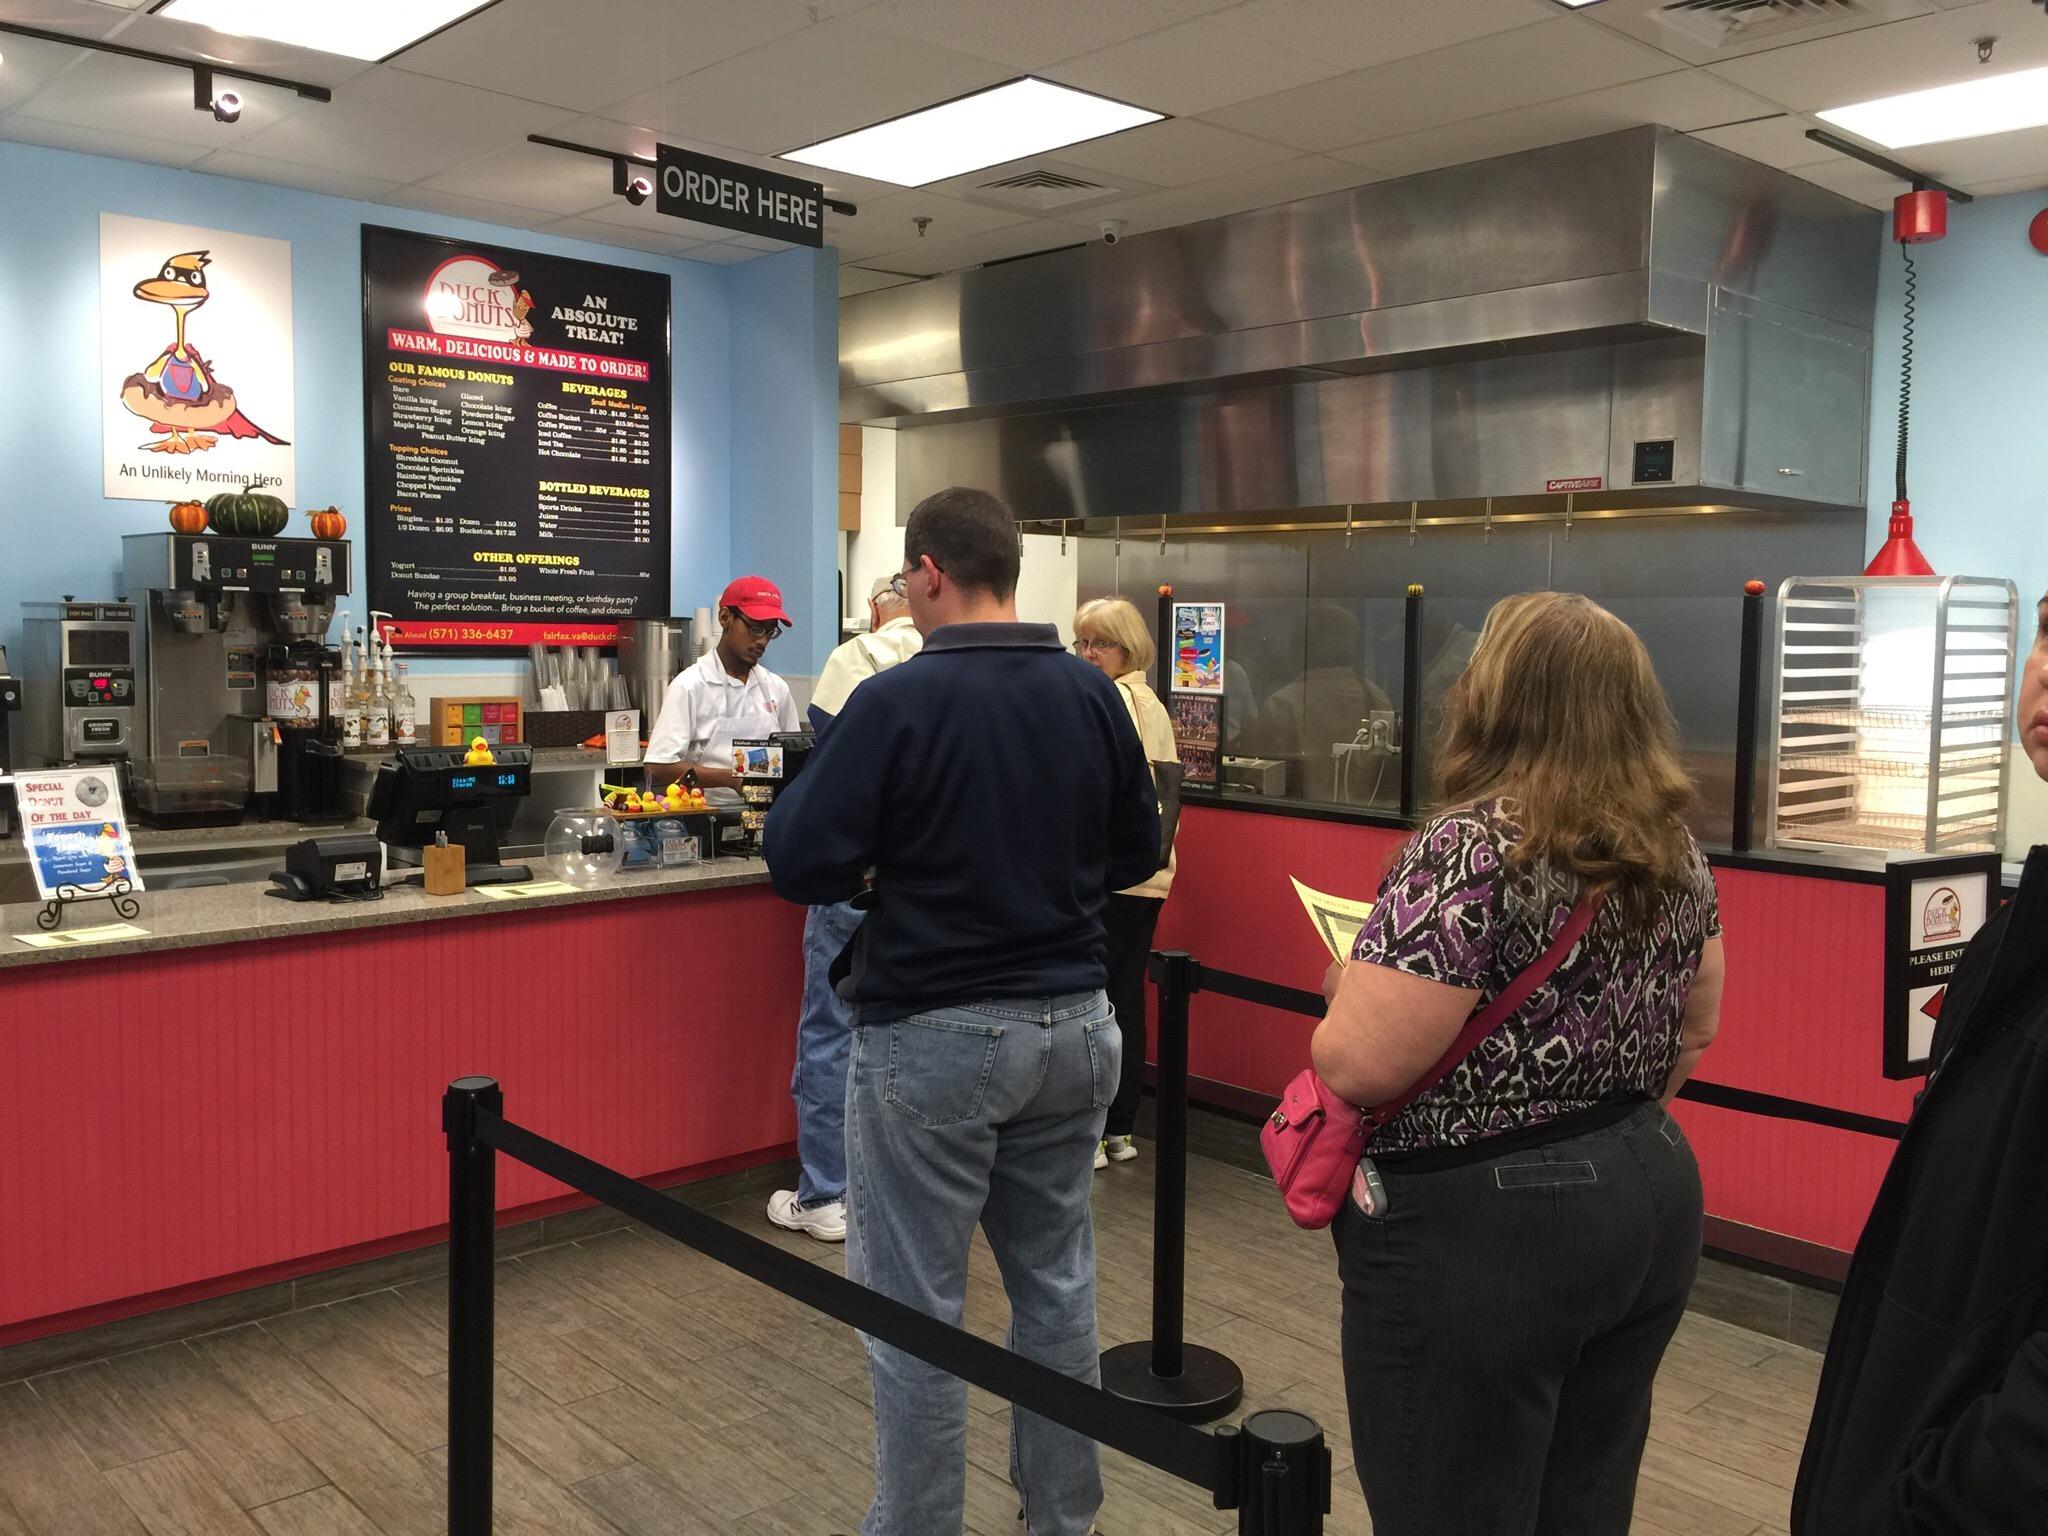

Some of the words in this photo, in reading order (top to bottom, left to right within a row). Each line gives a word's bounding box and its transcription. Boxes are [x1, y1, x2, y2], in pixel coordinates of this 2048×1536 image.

[663, 166, 750, 214] ORDER
[758, 187, 818, 229] HERE
[583, 295, 607, 310] AN
[438, 302, 520, 328] ONUTS
[551, 307, 638, 331] ABSOLUTE
[566, 325, 624, 345] TREAT!
[392, 333, 442, 354] WARM,
[446, 340, 520, 362] DELICIOUS
[524, 350, 534, 363] &
[539, 352, 576, 369] MADE
[579, 358, 597, 371] TO
[600, 361, 647, 378] ORDER!
[389, 362, 415, 374] OUR
[418, 365, 465, 380] FAMOUS
[468, 371, 514, 385] DONUTS
[388, 375, 416, 386] Coating
[419, 379, 447, 389] Choices
[562, 382, 628, 399] BEVERAGES
[393, 394, 418, 403] Vanilla
[420, 397, 438, 406] Icing
[538, 402, 558, 410] Coffee
[591, 398, 607, 407] Small
[632, 403, 647, 412] Large
[393, 403, 429, 413] Cinnamon
[430, 407, 452, 415] Sugar
[461, 402, 493, 411] Chocolate
[495, 405, 513, 413] Icing
[393, 412, 432, 422] Strawberry
[434, 416, 452, 425] Icing
[461, 410, 494, 420] Powdered
[495, 413, 516, 422] Sugar
[538, 411, 558, 419] Coffee
[559, 414, 580, 422] Bucket
[394, 421, 415, 430] Maple
[417, 424, 434, 432] Icing
[461, 419, 484, 427] Lemon
[486, 421, 503, 430] Icing
[538, 421, 558, 429] Coffee
[559, 423, 582, 431] Flavors
[422, 432, 445, 441] Peanut
[447, 434, 467, 442] Butter
[469, 436, 485, 445] Icing
[461, 427, 487, 436] Orange
[488, 430, 506, 439] Icing
[389, 444, 418, 454] Topping
[420, 447, 448, 456] Choices
[552, 451, 581, 459] Chocolate
[396, 454, 429, 463] Shredded
[431, 457, 458, 466] Coconut
[120, 464, 137, 477] An
[142, 465, 192, 484] Unlikely
[197, 469, 250, 486] Morning
[254, 473, 283, 486] Hero
[396, 463, 430, 472] Chocolate
[431, 466, 464, 475] Sprinkles
[397, 472, 427, 480] Rainbow
[428, 475, 461, 483] Sprinkles
[397, 481, 427, 490] Chopped
[428, 484, 456, 492] Peanuts
[539, 481, 587, 494] BOTTLED
[589, 485, 650, 499] BEVERAGES
[397, 490, 418, 498] Bacon
[420, 492, 441, 500] Pieces
[539, 494, 557, 502] Sodas
[390, 505, 412, 513] Prices
[560, 505, 582, 513] Drinks
[397, 515, 423, 523] Singles
[460, 518, 480, 526] Dozen
[251, 543, 275, 551] BUNN
[474, 552, 514, 564] OTHER
[516, 554, 580, 566] OFFERINGS
[391, 562, 416, 570] Yogurt
[415, 572, 440, 580] Sundae
[408, 590, 436, 600] Having
[445, 593, 469, 601] group
[471, 592, 508, 601] breakfast,
[510, 593, 542, 601] business
[543, 595, 575, 604] meeting,
[586, 596, 615, 604] birthday
[616, 596, 638, 605] party?
[415, 602, 429, 610] The
[431, 603, 460, 612] perfect
[502, 604, 521, 614] Bring
[530, 605, 555, 613] bucket
[557, 605, 564, 613] of
[566, 606, 589, 614] coffee,
[606, 607, 633, 615] donuts!
[429, 629, 458, 641] (571)
[461, 630, 514, 639] 336-6437
[26, 783, 64, 793] SPECIAL
[50, 813, 68, 822] THE
[73, 811, 91, 820] DAY
[1910, 952, 1943, 966] PLEASE
[1945, 948, 1965, 960] ENT
